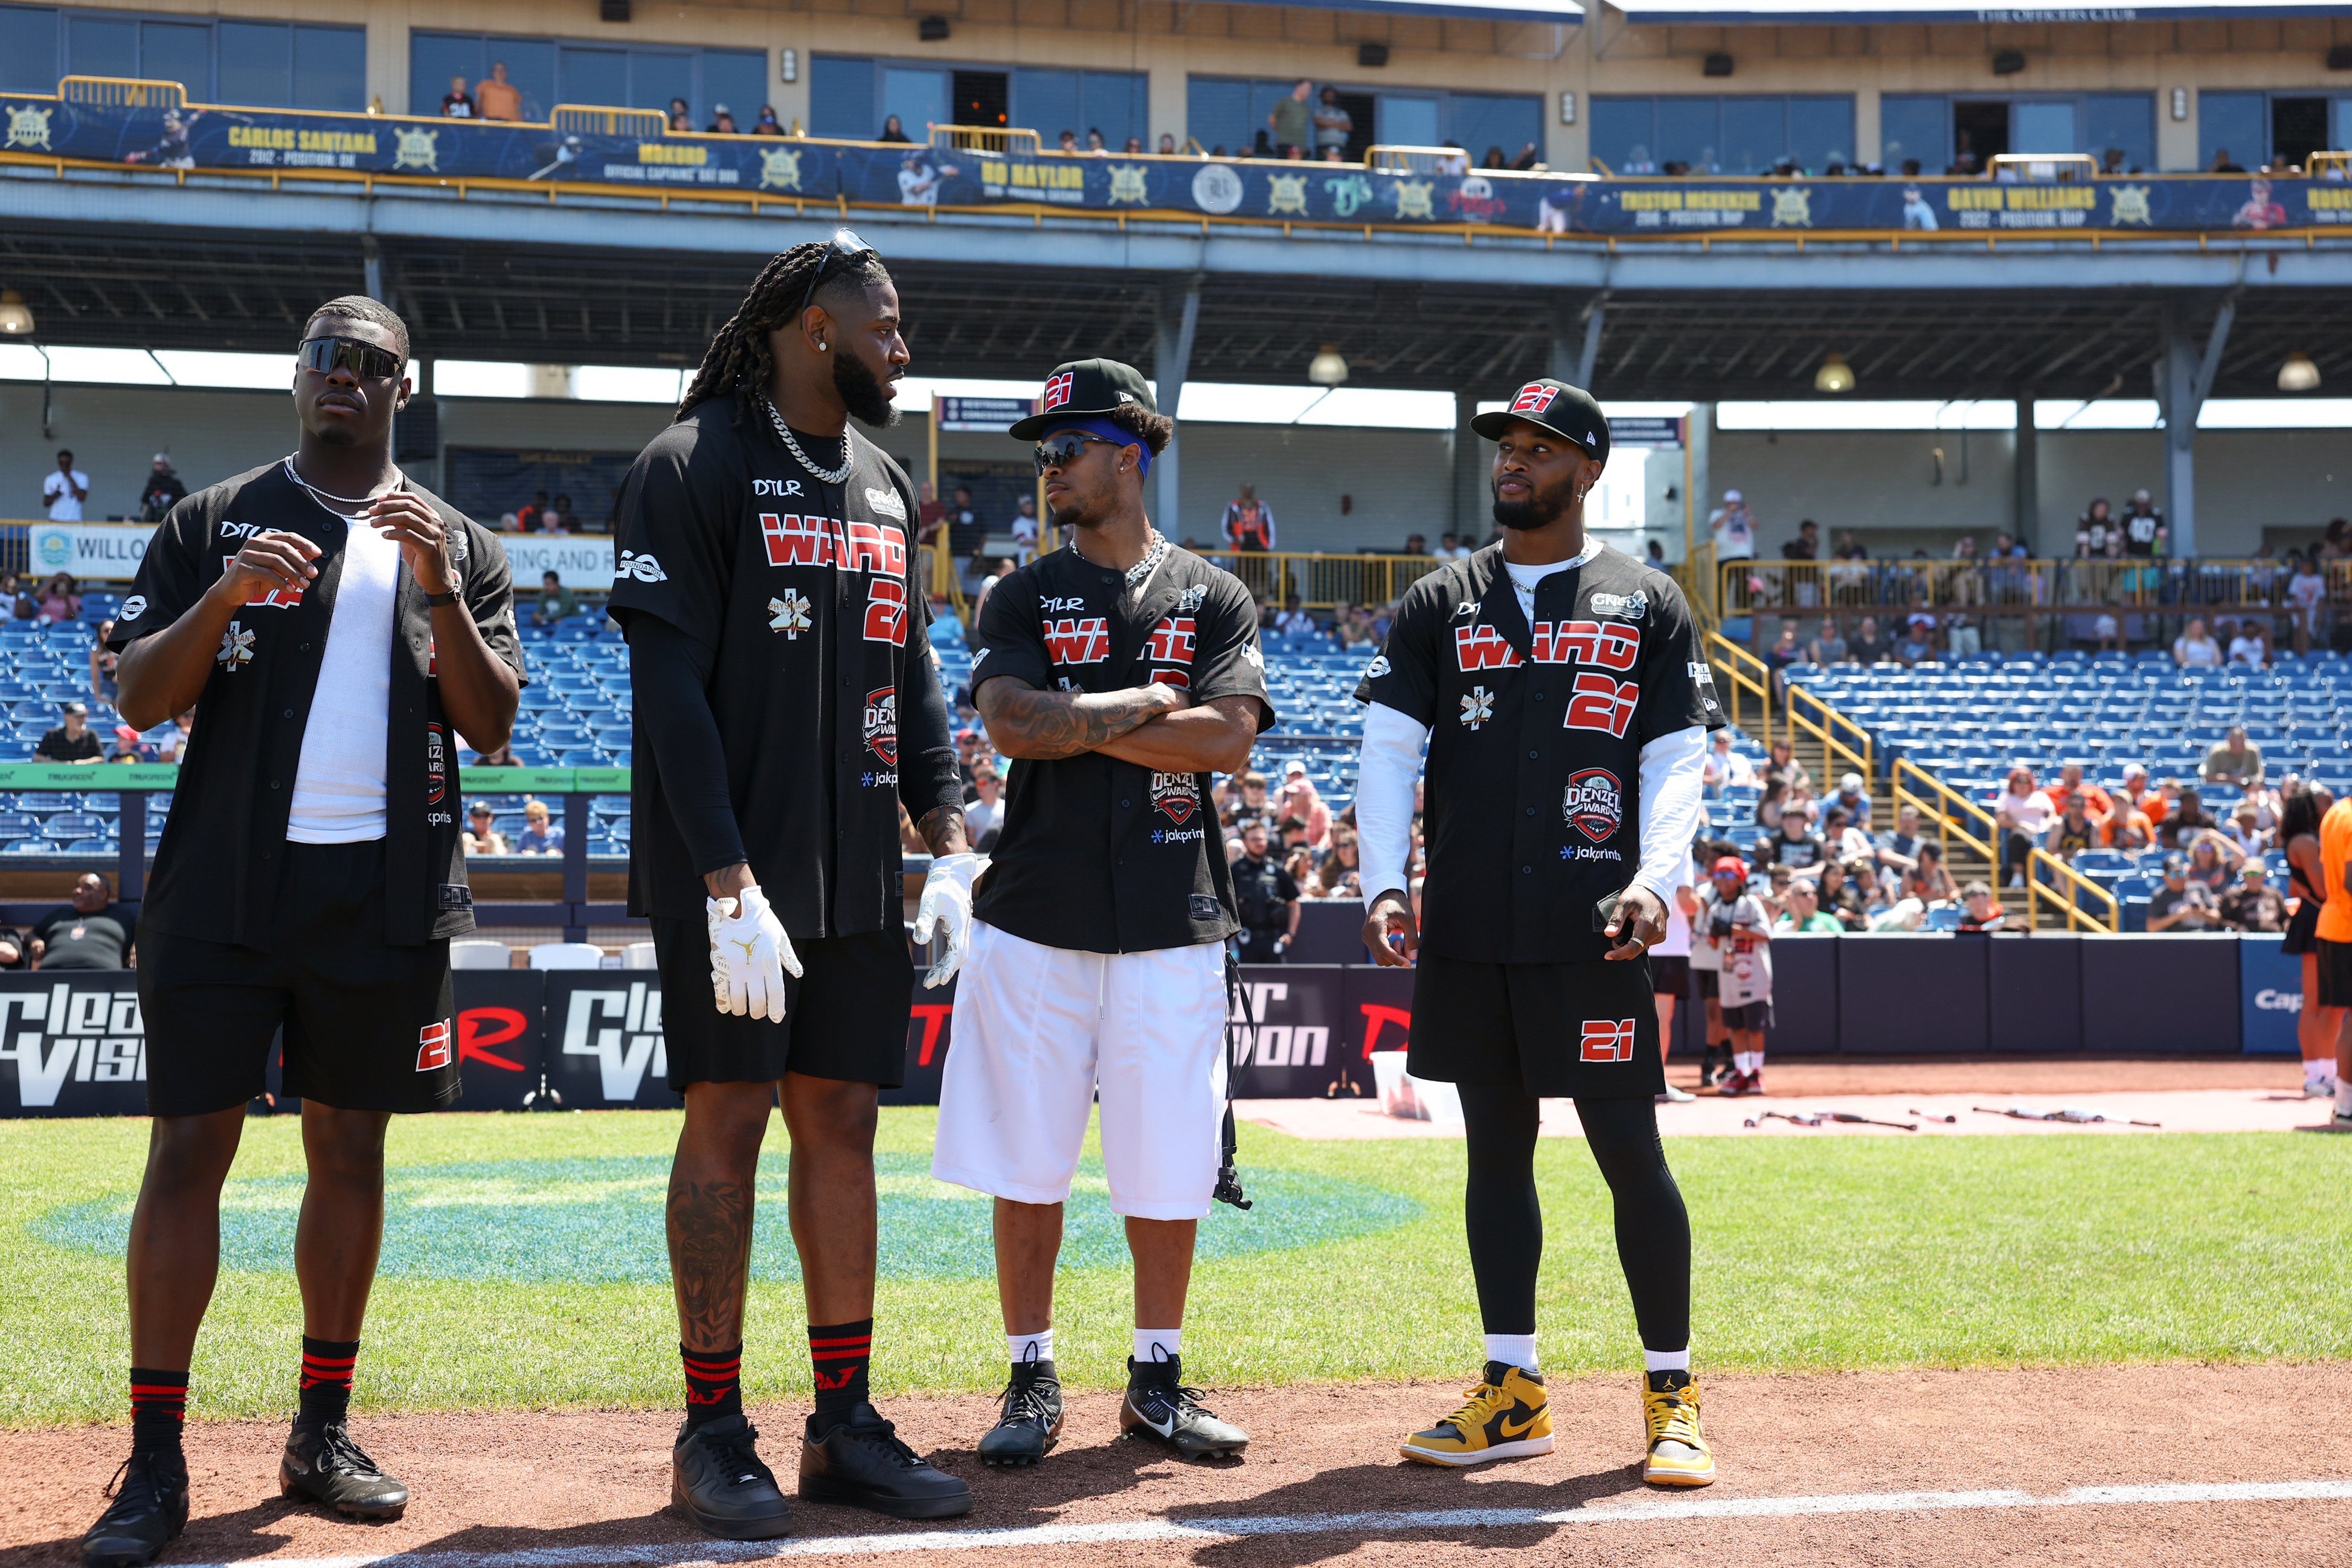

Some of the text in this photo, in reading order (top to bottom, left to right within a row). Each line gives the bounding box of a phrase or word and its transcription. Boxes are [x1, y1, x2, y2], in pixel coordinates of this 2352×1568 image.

[228, 126, 295, 150] CARLOS
[298, 129, 377, 154] SANTANA
[249, 149, 275, 164] 2012
[1011, 163, 1084, 189] NAYLOR
[2006, 187, 2095, 210] WILLIAMS
[1045, 371, 1074, 413] 21
[1511, 384, 1560, 414] 21
[753, 479, 804, 496] DTLR
[77, 539, 146, 559] WILLO
[759, 513, 905, 579] WARD
[509, 548, 553, 571] SING
[557, 550, 598, 571] AND
[621, 561, 661, 577] FOUNDATION
[768, 601, 810, 611] PHYSICIANS
[863, 577, 907, 648] 21
[1457, 602, 1481, 615] DT
[222, 634, 255, 643] HYSICIANS
[1455, 620, 1640, 672] WARD
[1460, 695, 1494, 706] PHYSICIANS
[1563, 672, 1639, 739] 21
[1152, 772, 1199, 791] DENZEL
[1166, 786, 1189, 795] WARD
[1565, 787, 1621, 813] DENZEL
[1584, 803, 1611, 815] WARD
[1165, 828, 1205, 843] jakprin
[1575, 846, 1622, 863] jakprints
[2255, 988, 2304, 1014] Cap
[0, 983, 145, 1059] Clea
[416, 1017, 452, 1072] 21
[1579, 1018, 1636, 1062] 21
